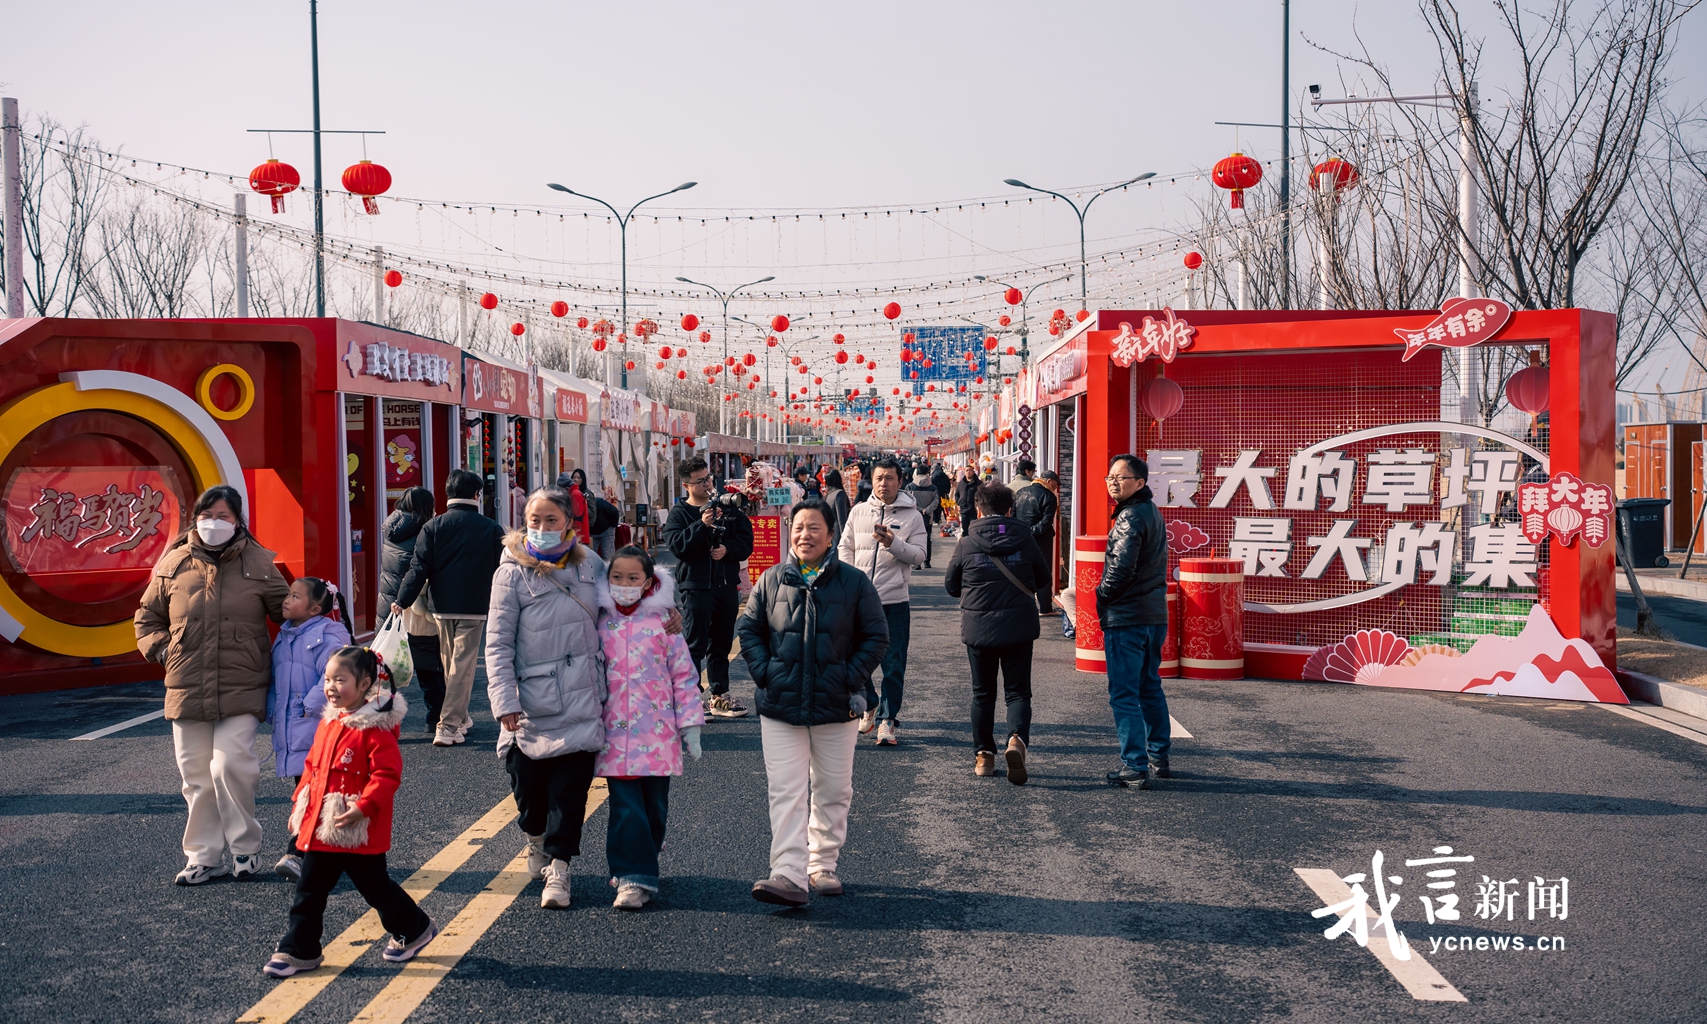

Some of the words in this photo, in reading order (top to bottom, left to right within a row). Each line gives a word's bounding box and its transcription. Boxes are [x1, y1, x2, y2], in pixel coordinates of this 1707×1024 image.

[1111, 308, 1192, 365] 新年好
[1407, 307, 1486, 348] 年年有余
[350, 405, 363, 415] OF
[387, 404, 420, 414] HORSE
[1146, 447, 1521, 514] 最大的草坪
[1521, 475, 1609, 515] 拜大年
[1229, 516, 1539, 588] 最大的集
